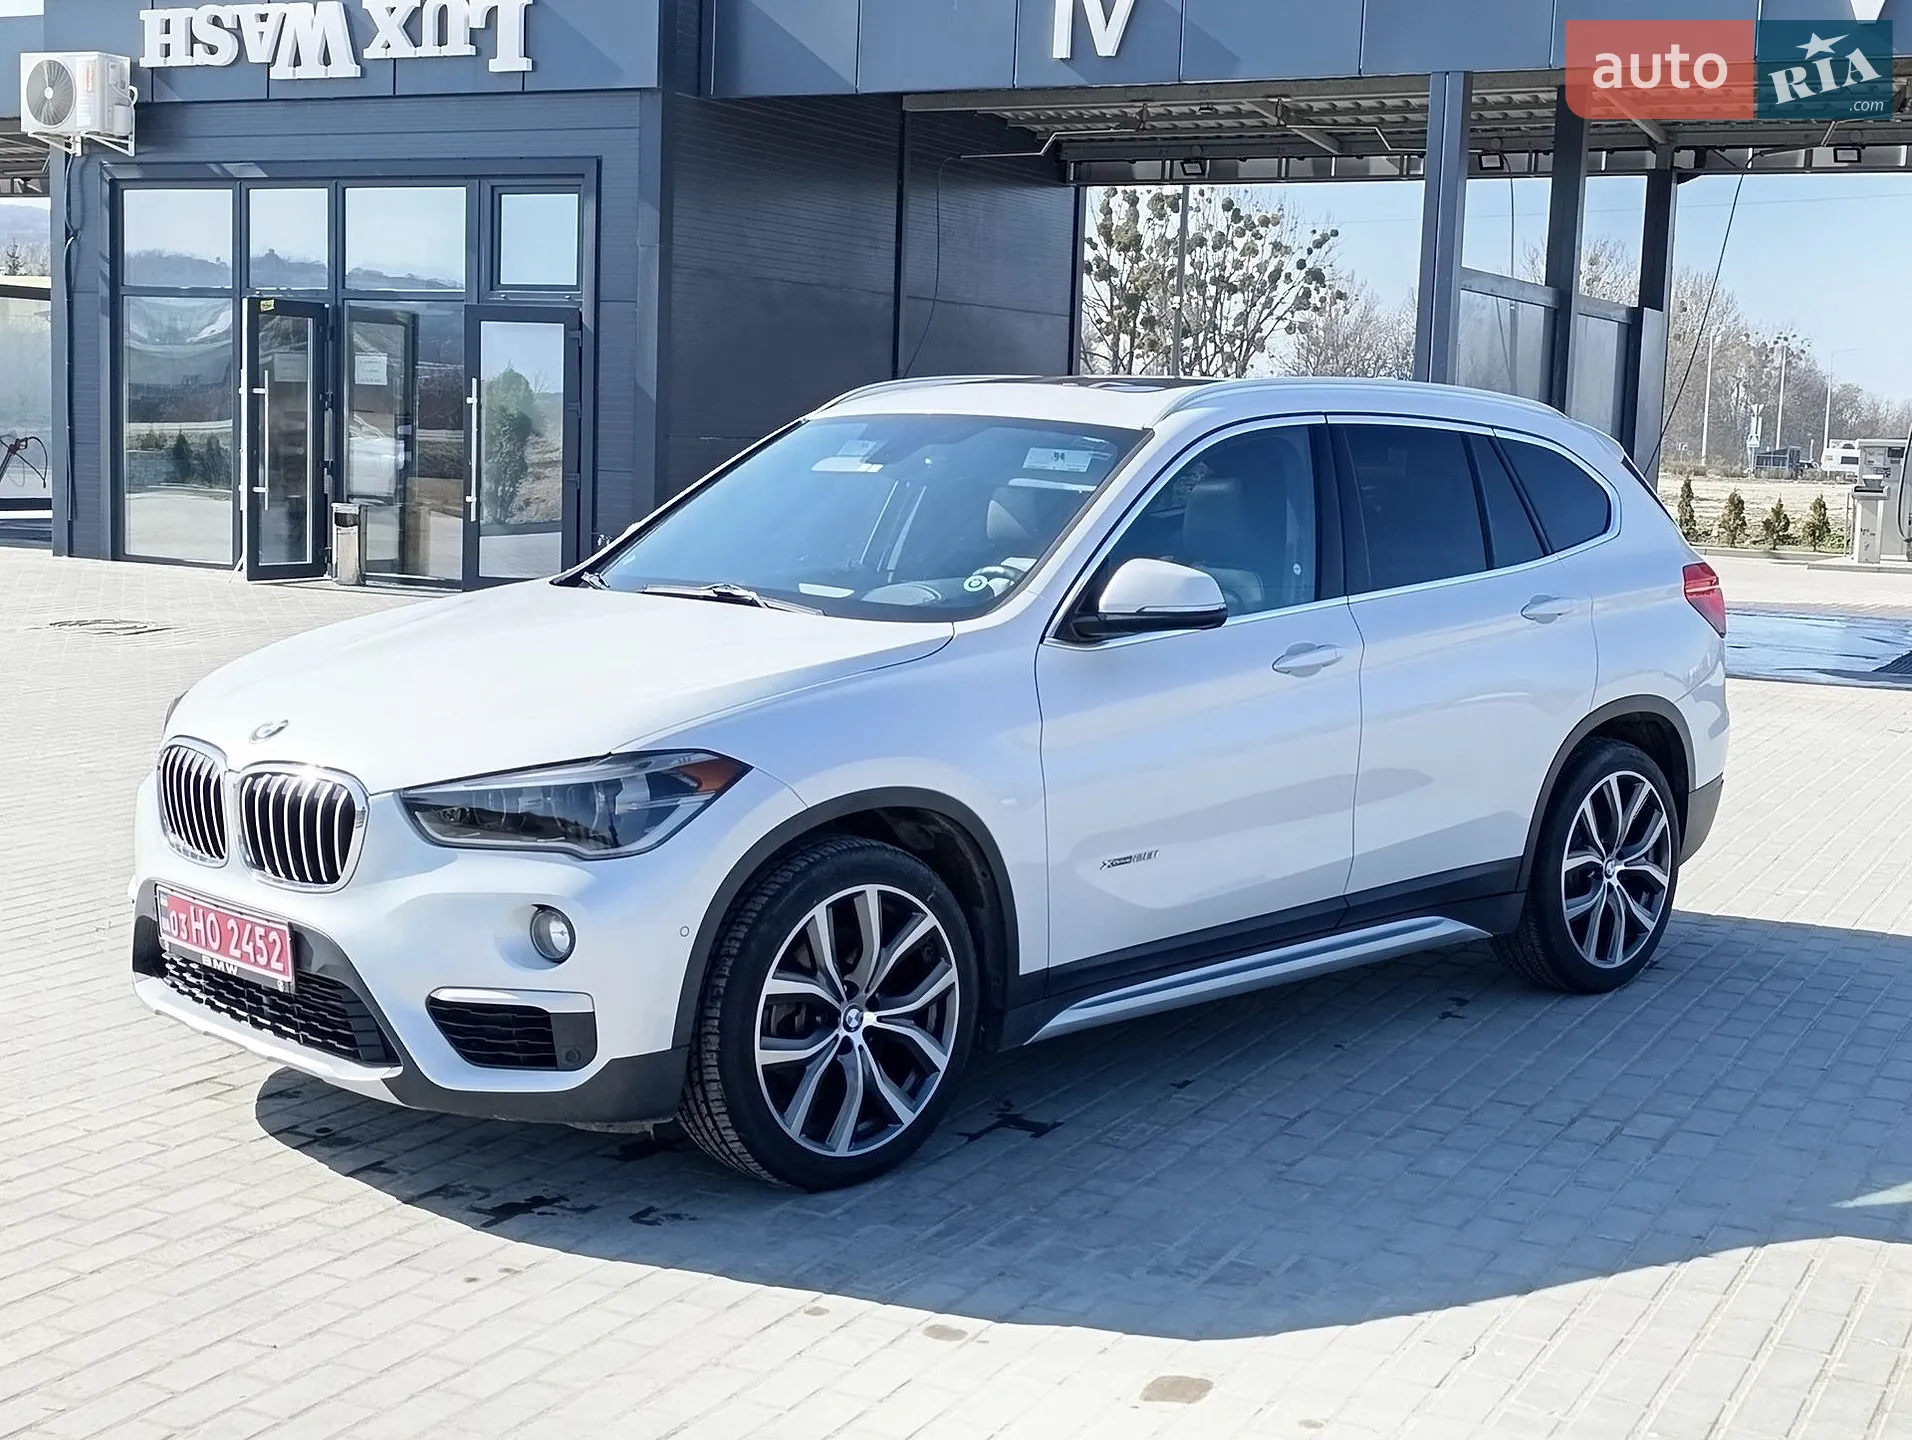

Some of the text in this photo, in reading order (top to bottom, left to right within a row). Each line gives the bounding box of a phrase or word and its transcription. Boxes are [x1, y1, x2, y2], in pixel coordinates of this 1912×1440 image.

[139, 0, 533, 80] LUX WASH
[202, 955, 238, 976] BMW
[227, 918, 285, 972] 2452
